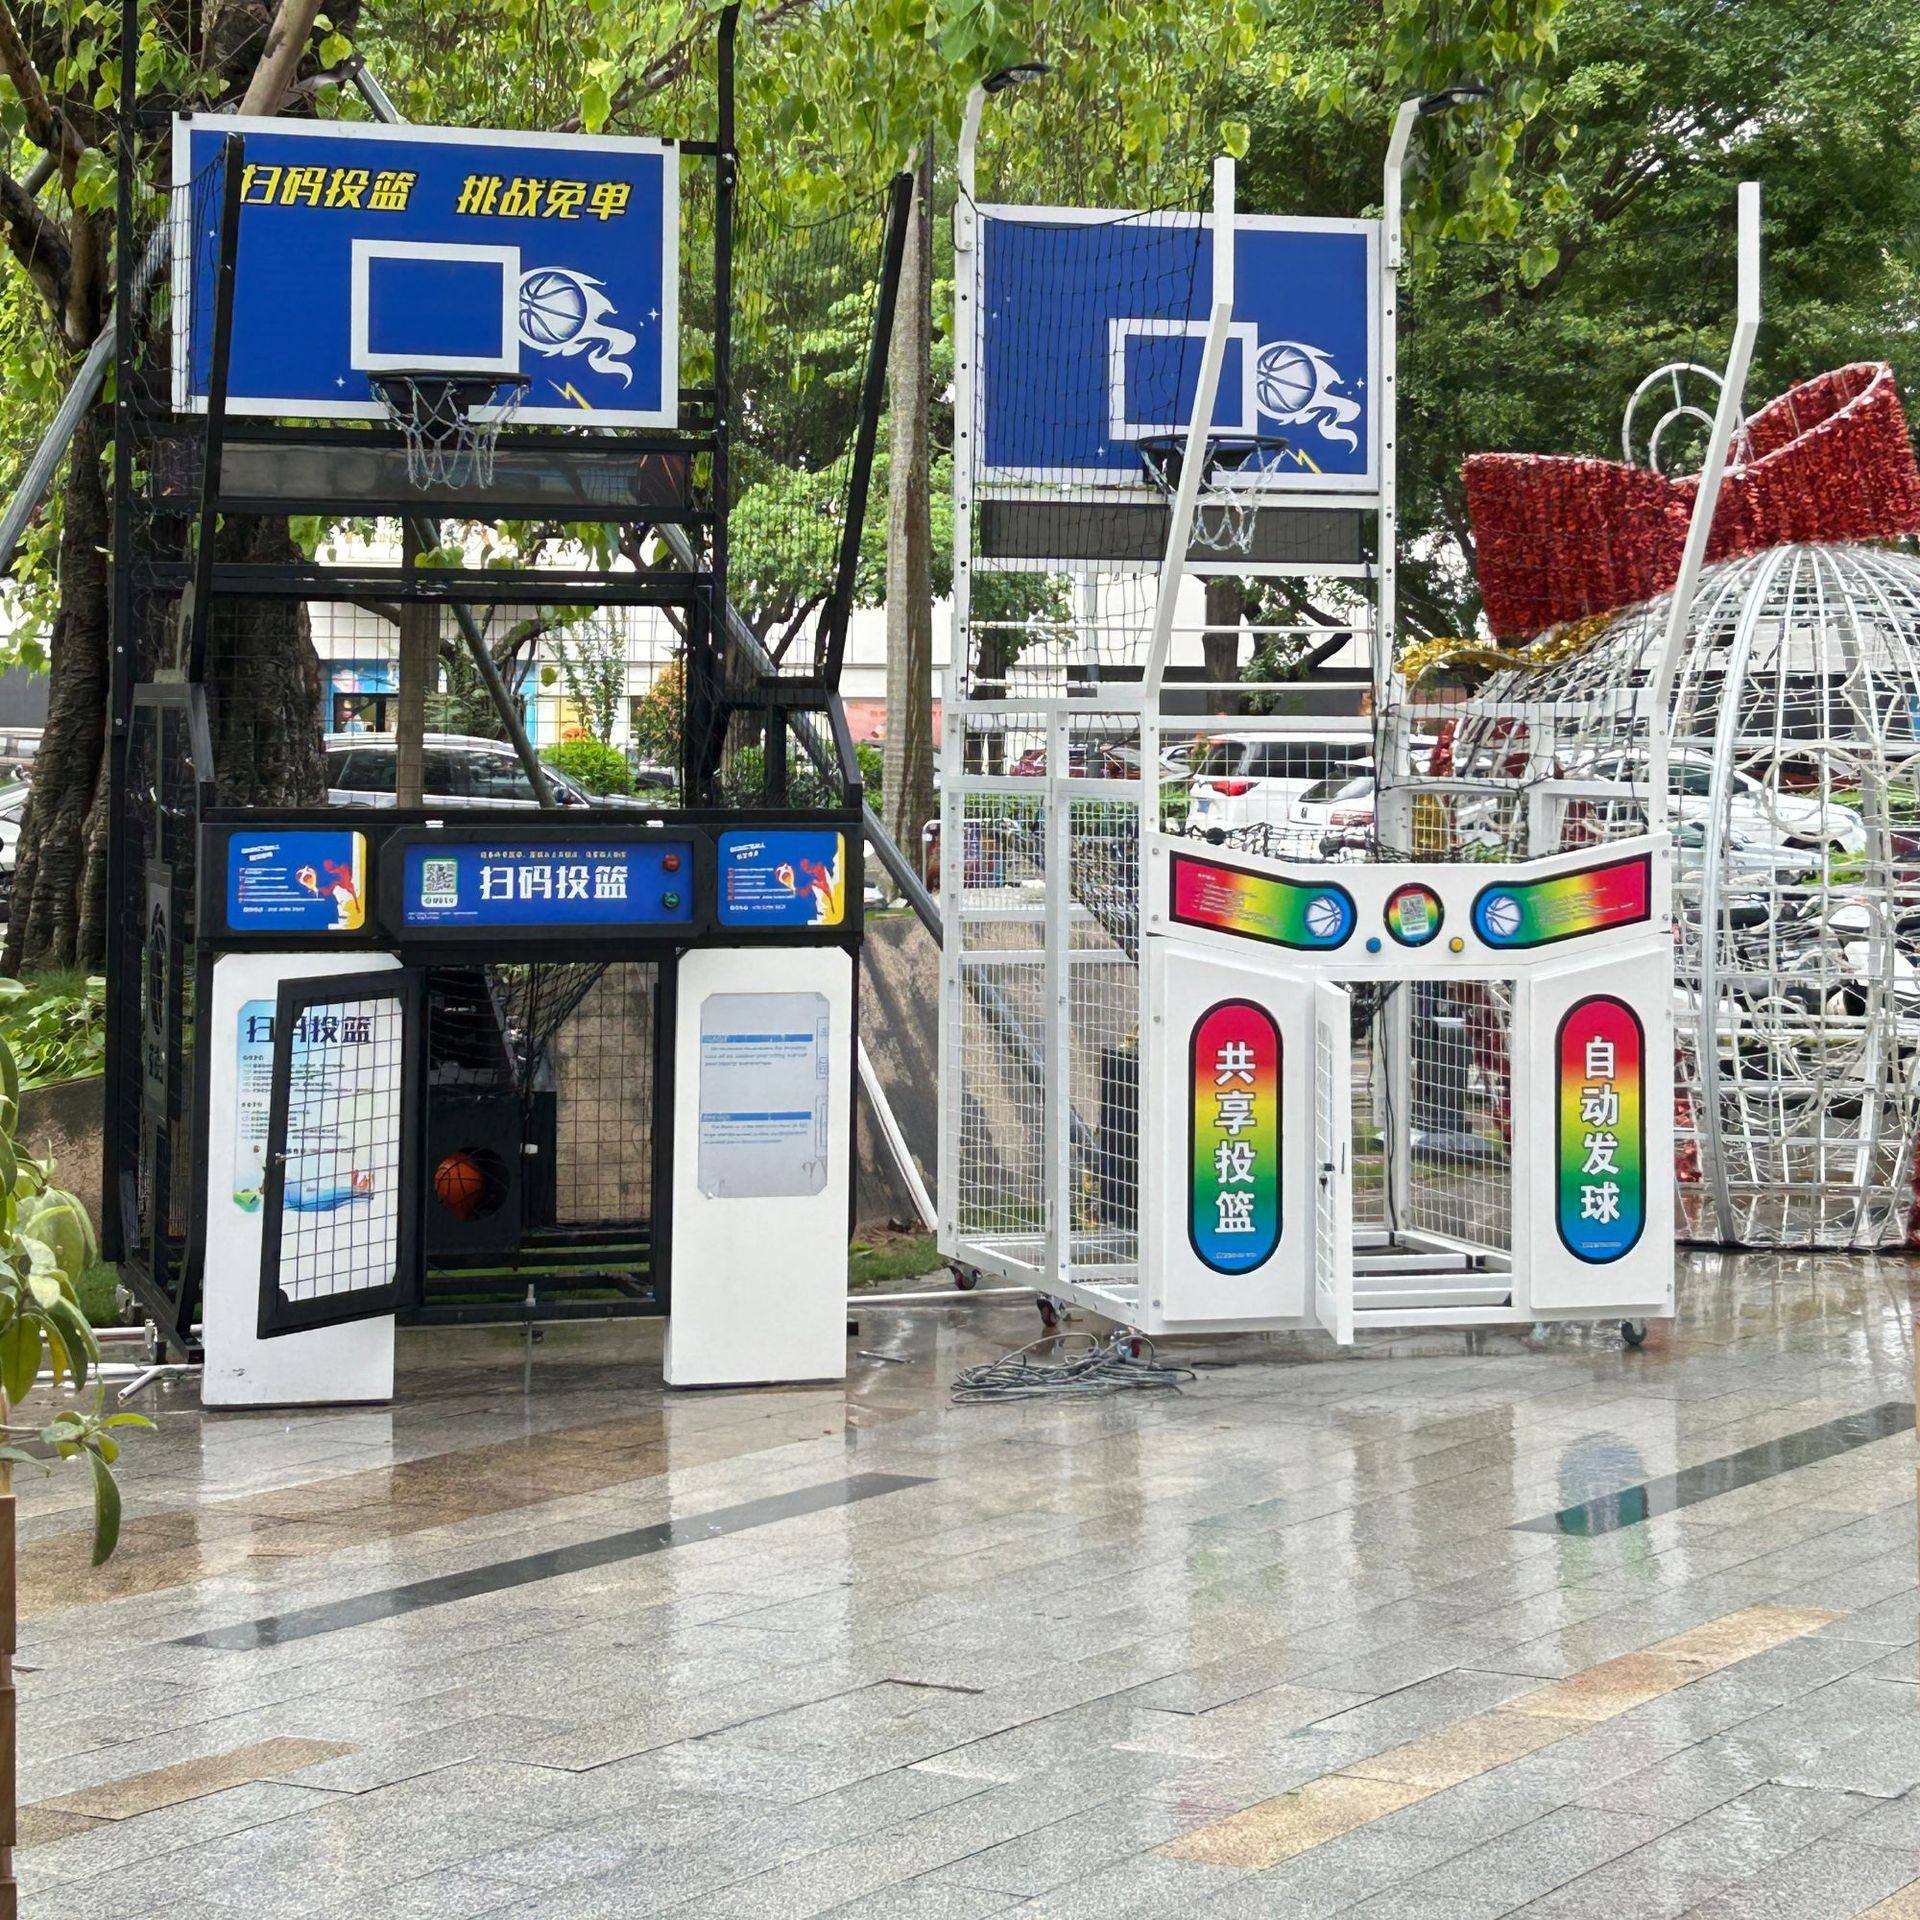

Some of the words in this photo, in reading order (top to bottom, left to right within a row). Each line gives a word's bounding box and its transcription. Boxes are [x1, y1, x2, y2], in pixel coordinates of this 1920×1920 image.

[240, 164, 417, 210] 扫码投篮
[457, 176, 631, 221] 挑战免单
[480, 865, 629, 900] 扫码投篮
[1213, 1039, 1257, 1234] 共享投篮
[1579, 1035, 1621, 1225] 自动发球
